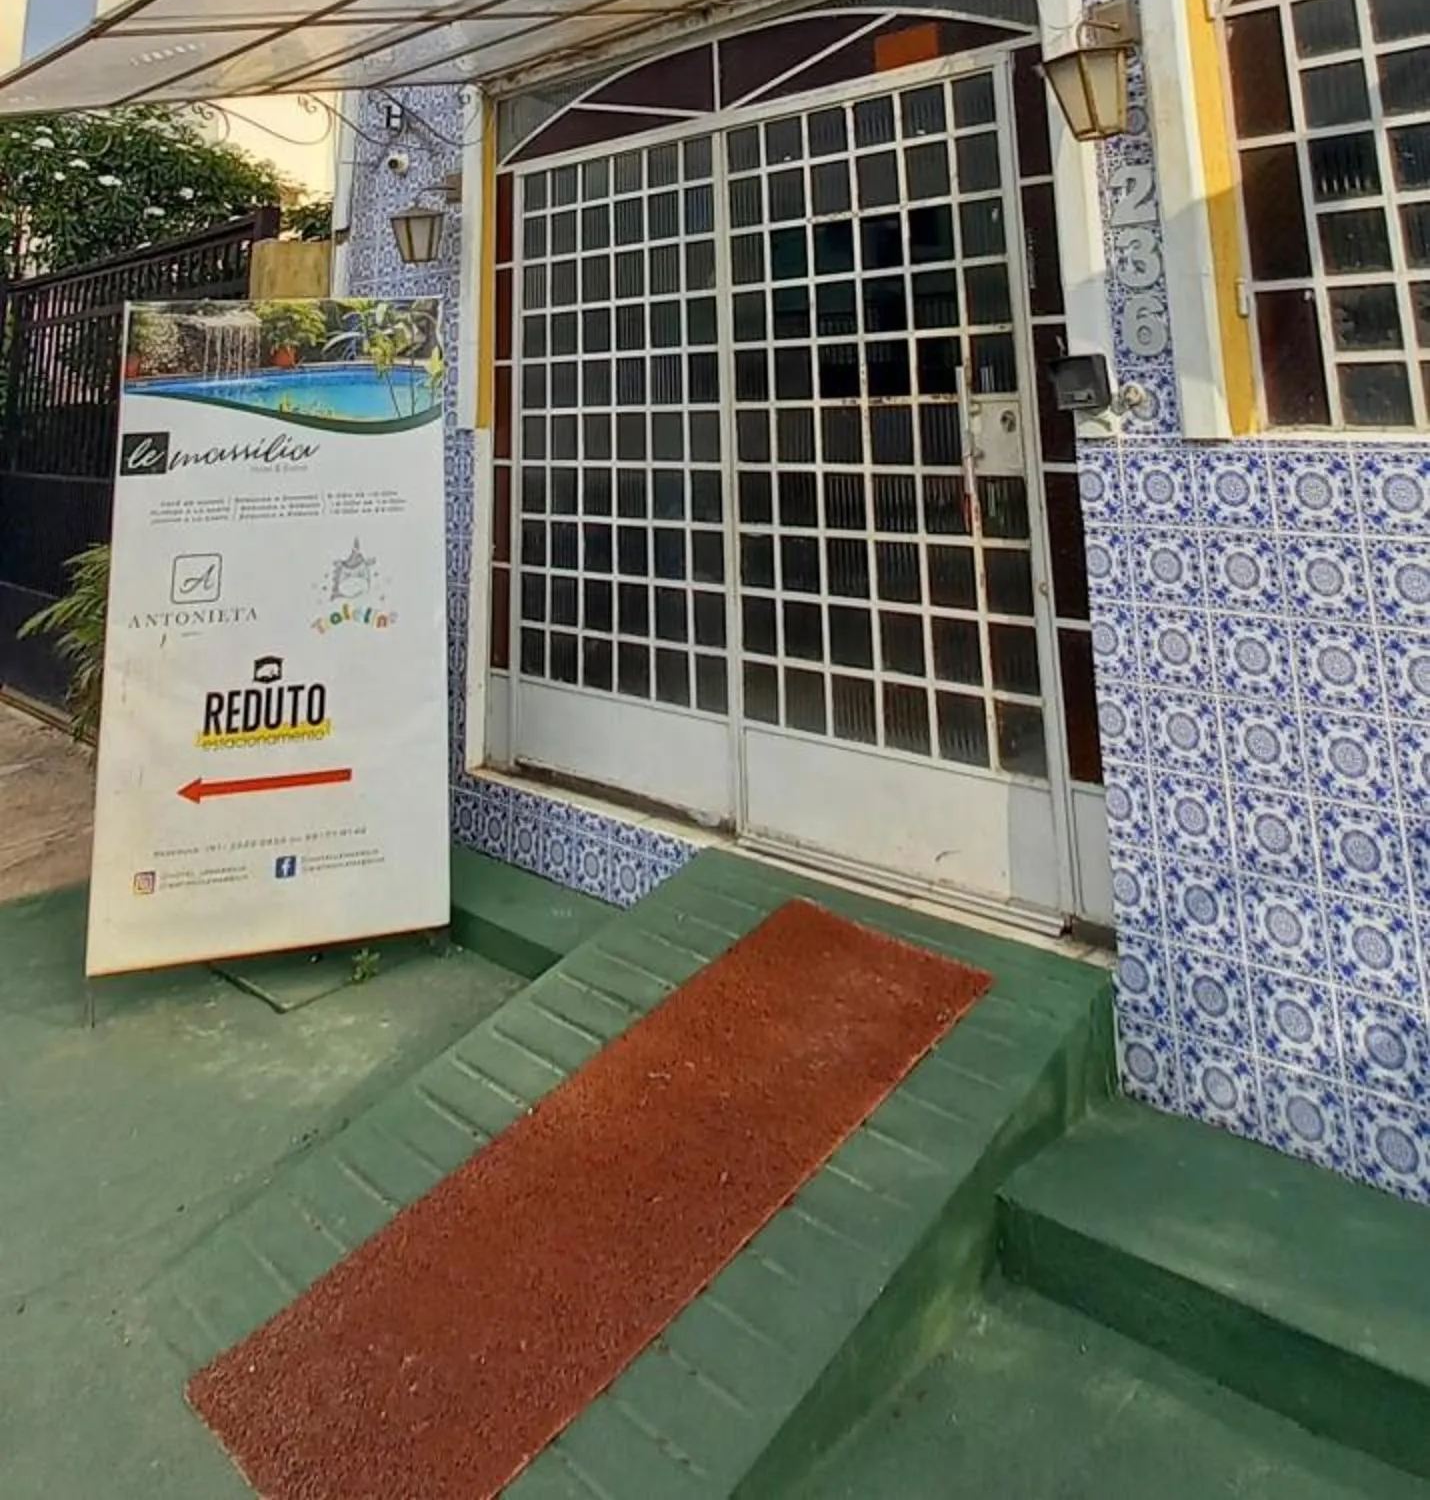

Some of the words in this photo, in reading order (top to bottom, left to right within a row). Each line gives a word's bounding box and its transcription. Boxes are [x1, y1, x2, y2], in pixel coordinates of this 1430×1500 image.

[1109, 165, 1170, 357] 236
[127, 437, 166, 469] le
[168, 433, 321, 471] massilia
[127, 607, 258, 629] ANTONIETA
[203, 683, 326, 736] REDUTO
